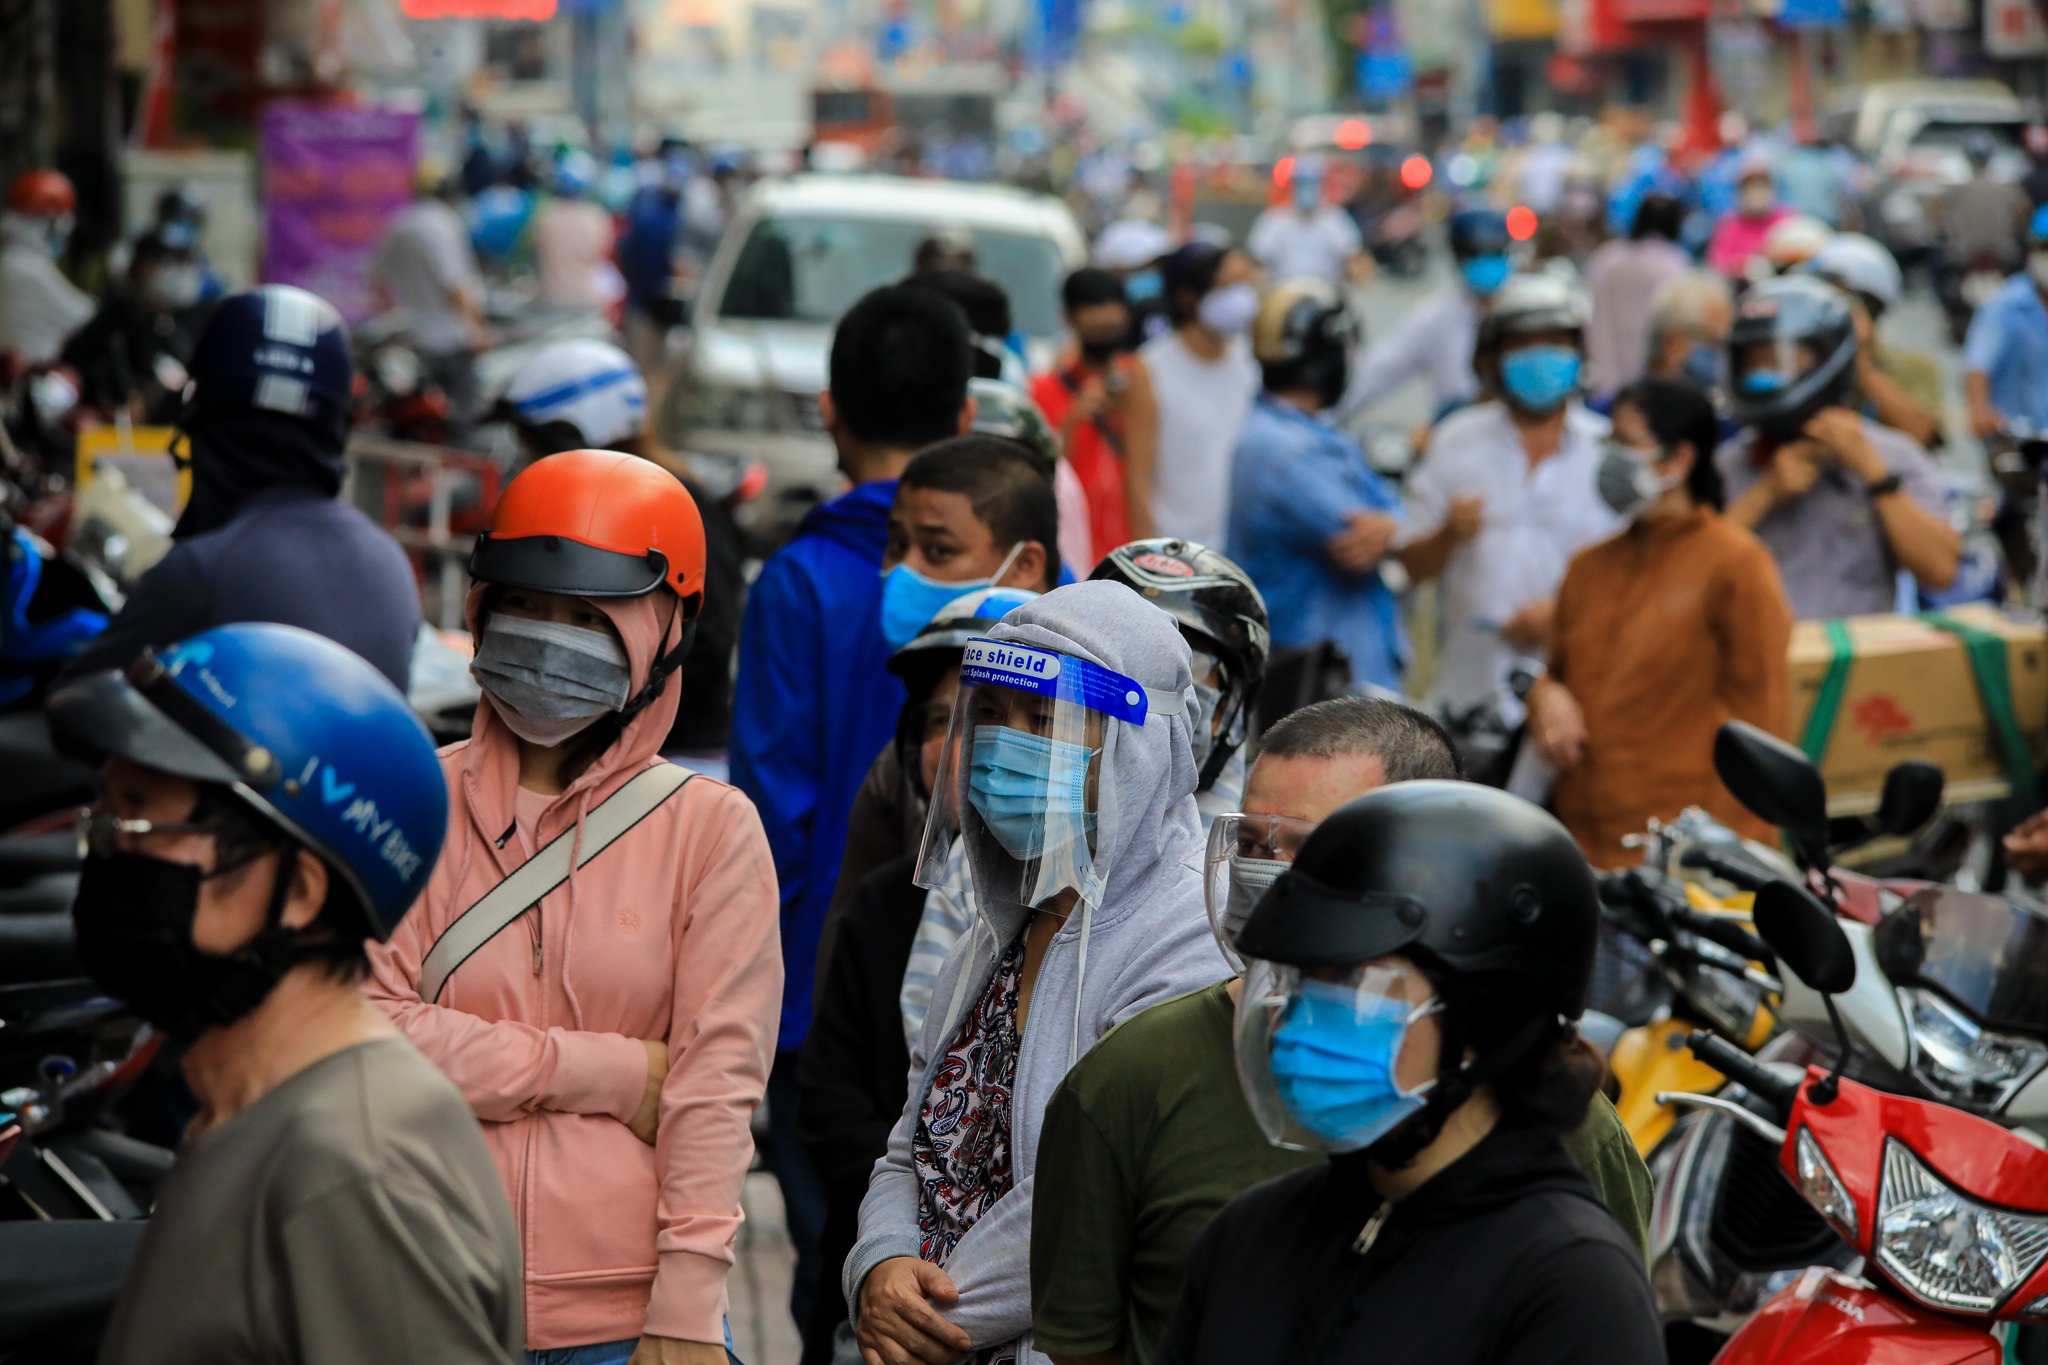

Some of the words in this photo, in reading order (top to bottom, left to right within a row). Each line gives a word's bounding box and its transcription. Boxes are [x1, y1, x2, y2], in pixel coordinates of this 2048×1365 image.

[987, 649, 1047, 673] shield
[970, 668, 991, 680] Splash
[991, 673, 1039, 689] protection
[340, 797, 394, 844] MY
